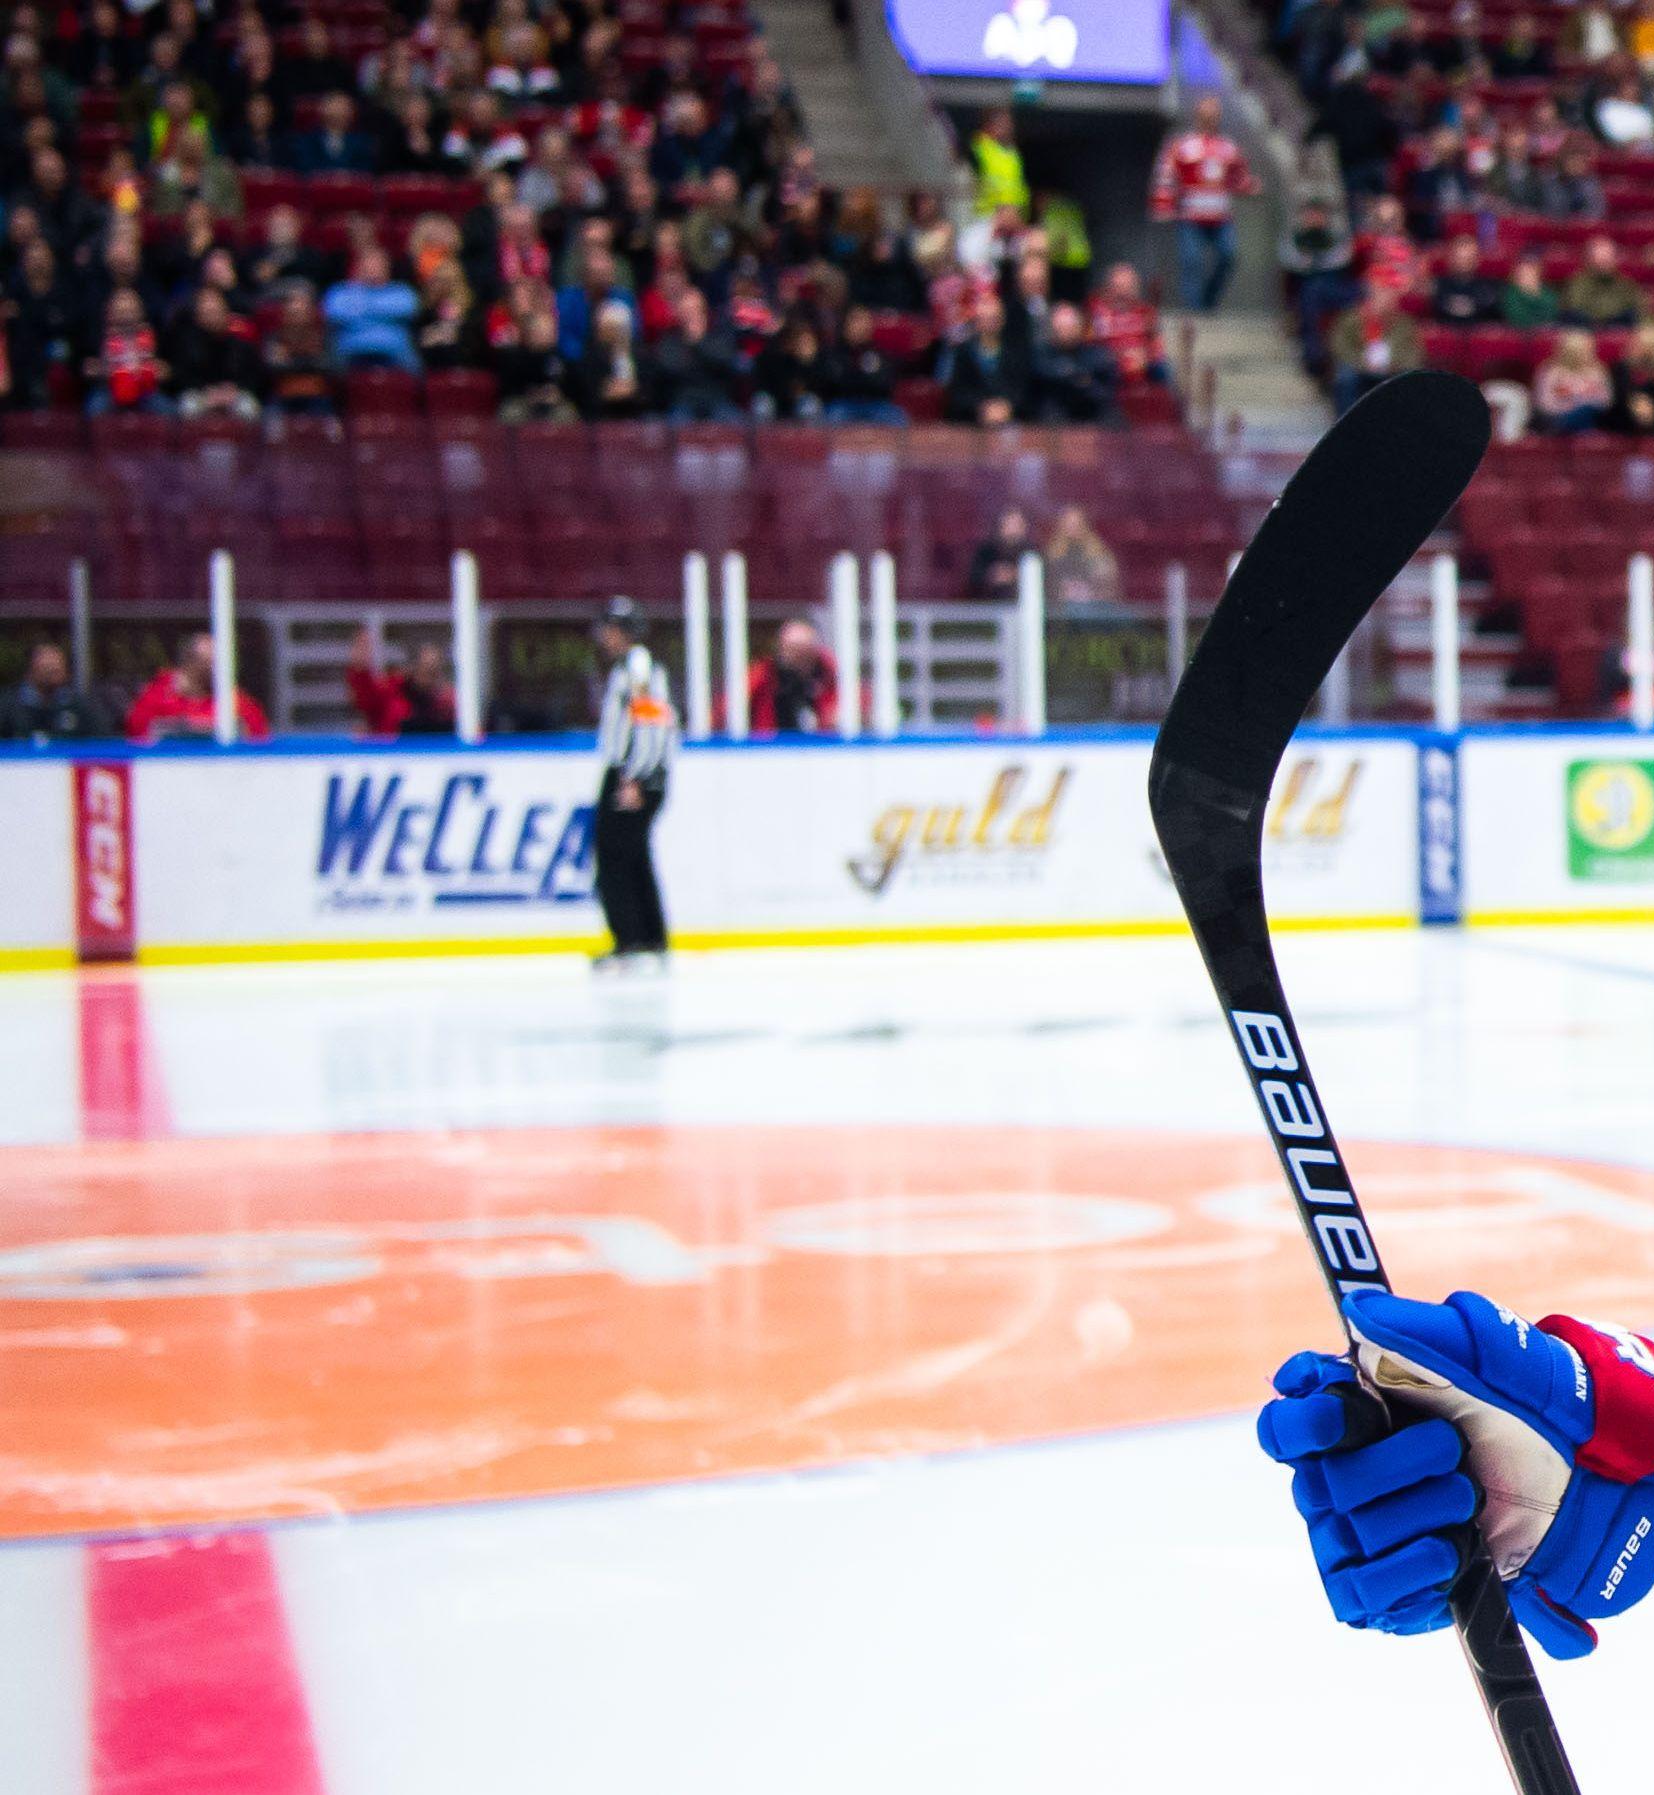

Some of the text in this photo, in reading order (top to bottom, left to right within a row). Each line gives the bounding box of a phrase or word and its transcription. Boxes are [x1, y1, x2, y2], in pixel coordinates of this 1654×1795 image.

[847, 762, 1073, 892] guld
[1231, 1010, 1388, 1293] BAUE
[1600, 1516, 1652, 1600] BAUER
